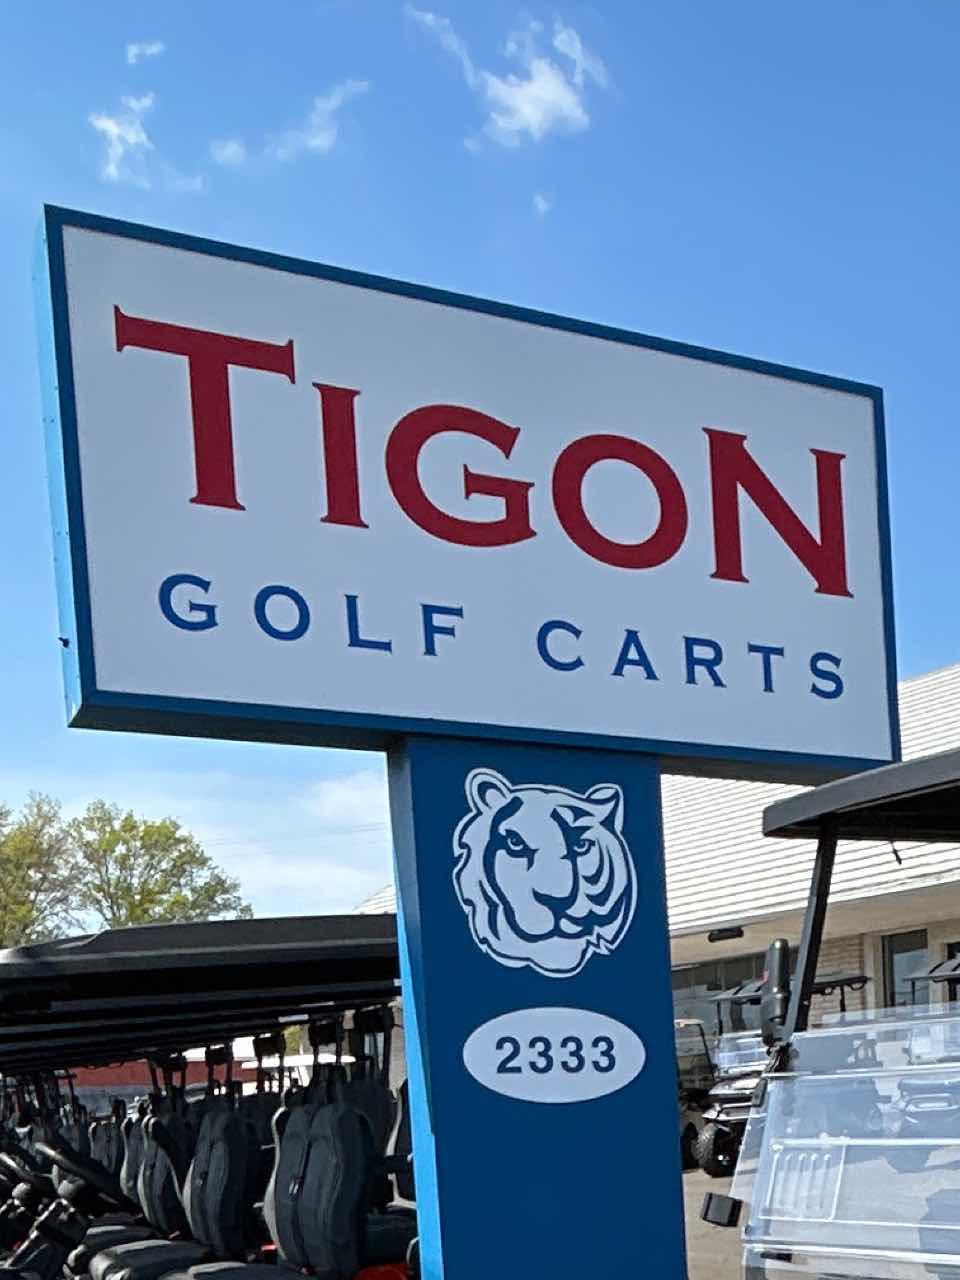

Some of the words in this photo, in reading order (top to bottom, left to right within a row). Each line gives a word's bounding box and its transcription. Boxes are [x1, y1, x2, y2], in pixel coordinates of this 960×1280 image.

[115, 305, 853, 597] TIGON
[159, 573, 463, 657] GOLF
[537, 620, 845, 699] CARTS
[496, 1036, 617, 1074] 2333
